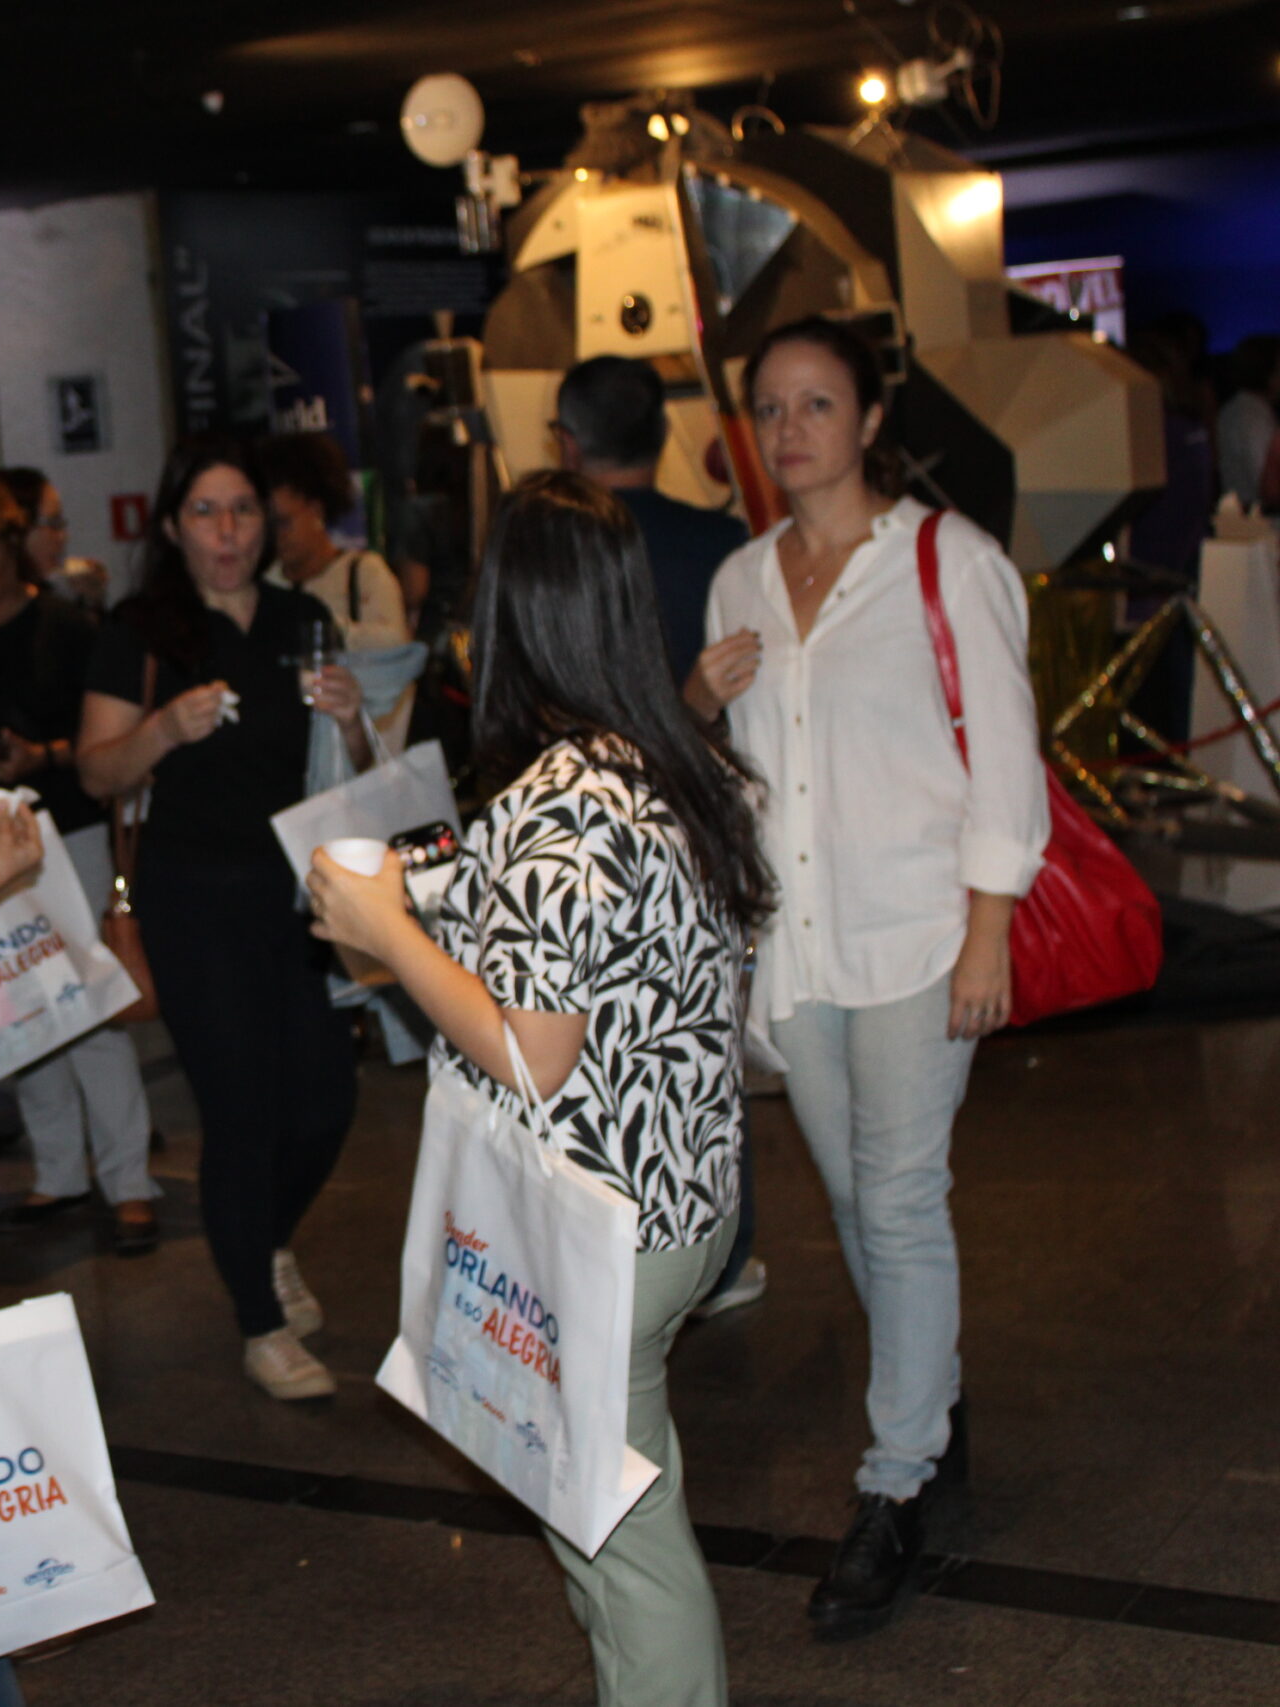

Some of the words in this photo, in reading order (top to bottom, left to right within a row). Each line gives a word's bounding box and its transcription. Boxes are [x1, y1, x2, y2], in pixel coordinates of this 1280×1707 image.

[444, 1210, 489, 1252] Vender
[445, 1237, 559, 1345] ORLANDO
[481, 1306, 561, 1393] ALEGRIA
